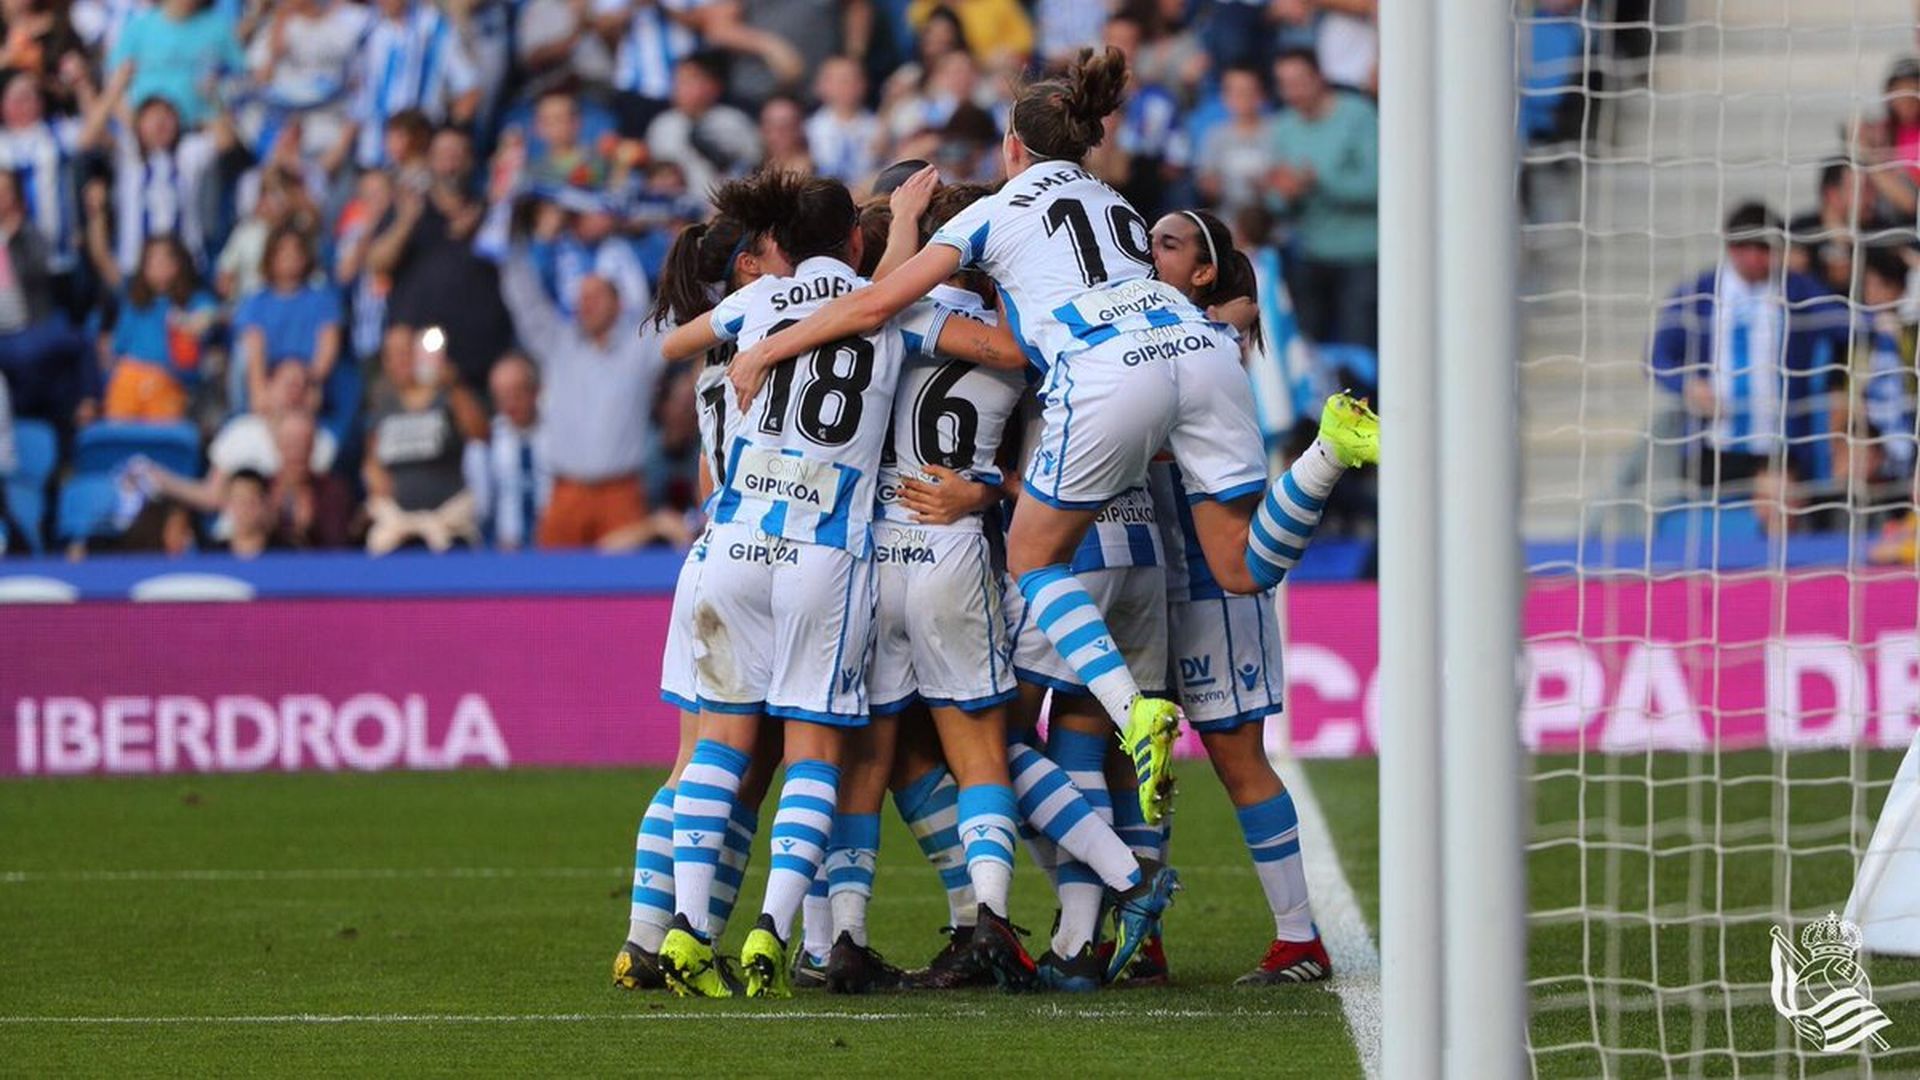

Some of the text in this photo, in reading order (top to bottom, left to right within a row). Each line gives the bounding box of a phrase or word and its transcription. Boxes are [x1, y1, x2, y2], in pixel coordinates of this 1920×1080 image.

[758, 318, 874, 447] 18
[1180, 654, 1211, 679] DV
[1264, 641, 1708, 757] CPA
[15, 693, 509, 773] IBERDROLA
